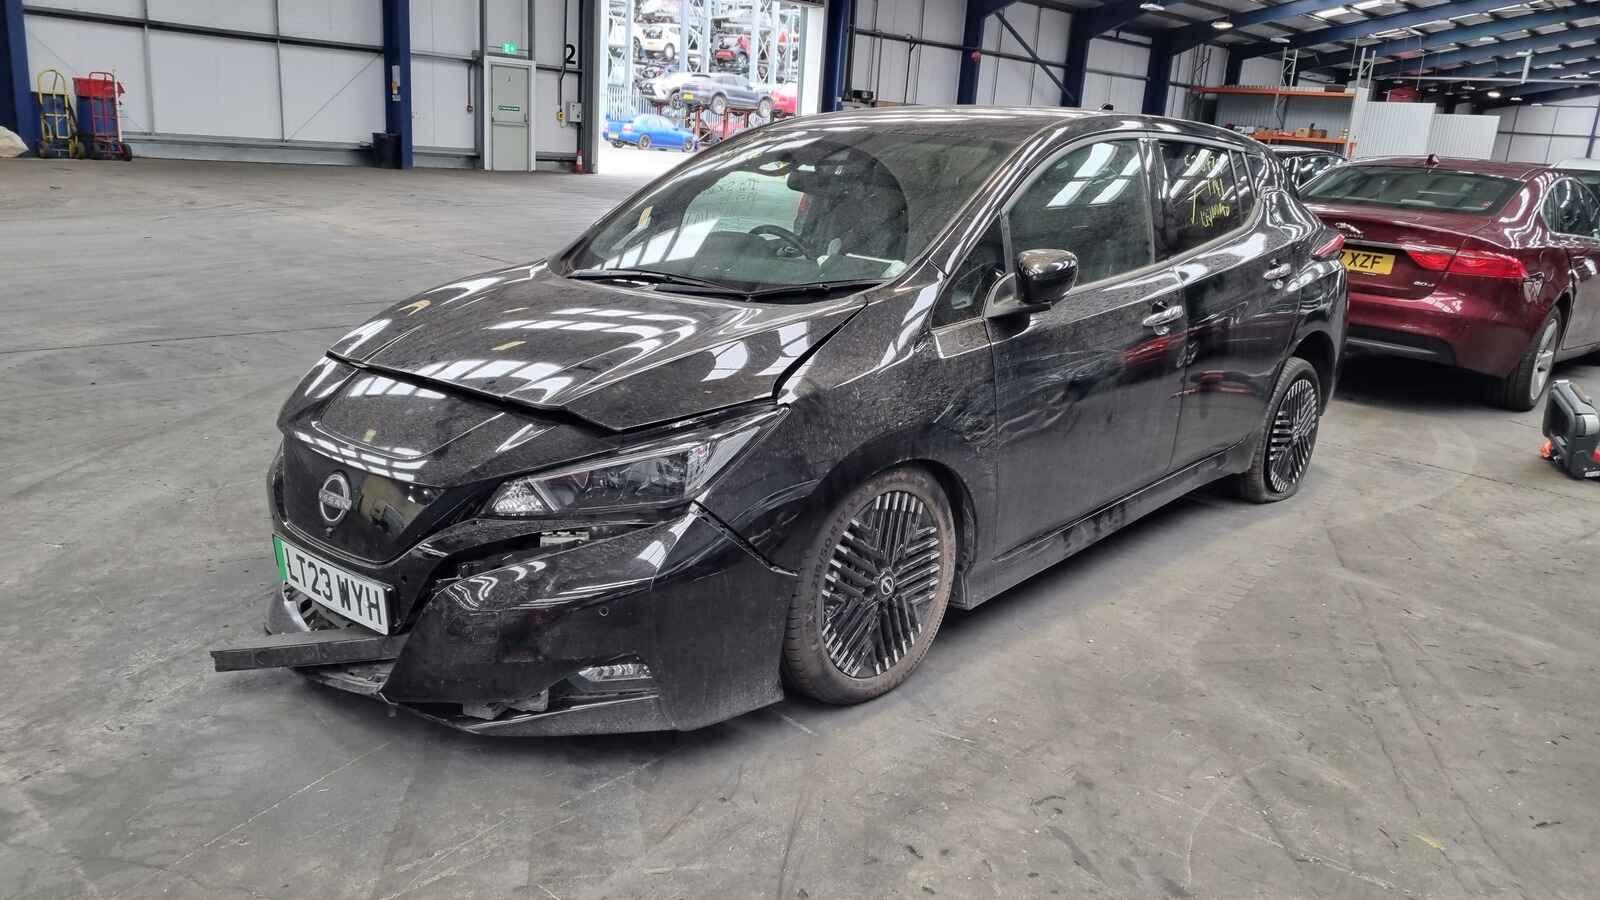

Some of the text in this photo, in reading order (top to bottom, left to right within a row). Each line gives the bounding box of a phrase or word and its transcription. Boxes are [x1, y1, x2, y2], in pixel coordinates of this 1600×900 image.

[565, 43, 576, 65] 2
[1347, 252, 1383, 269] XZF
[285, 547, 383, 626] LT23 WYH
